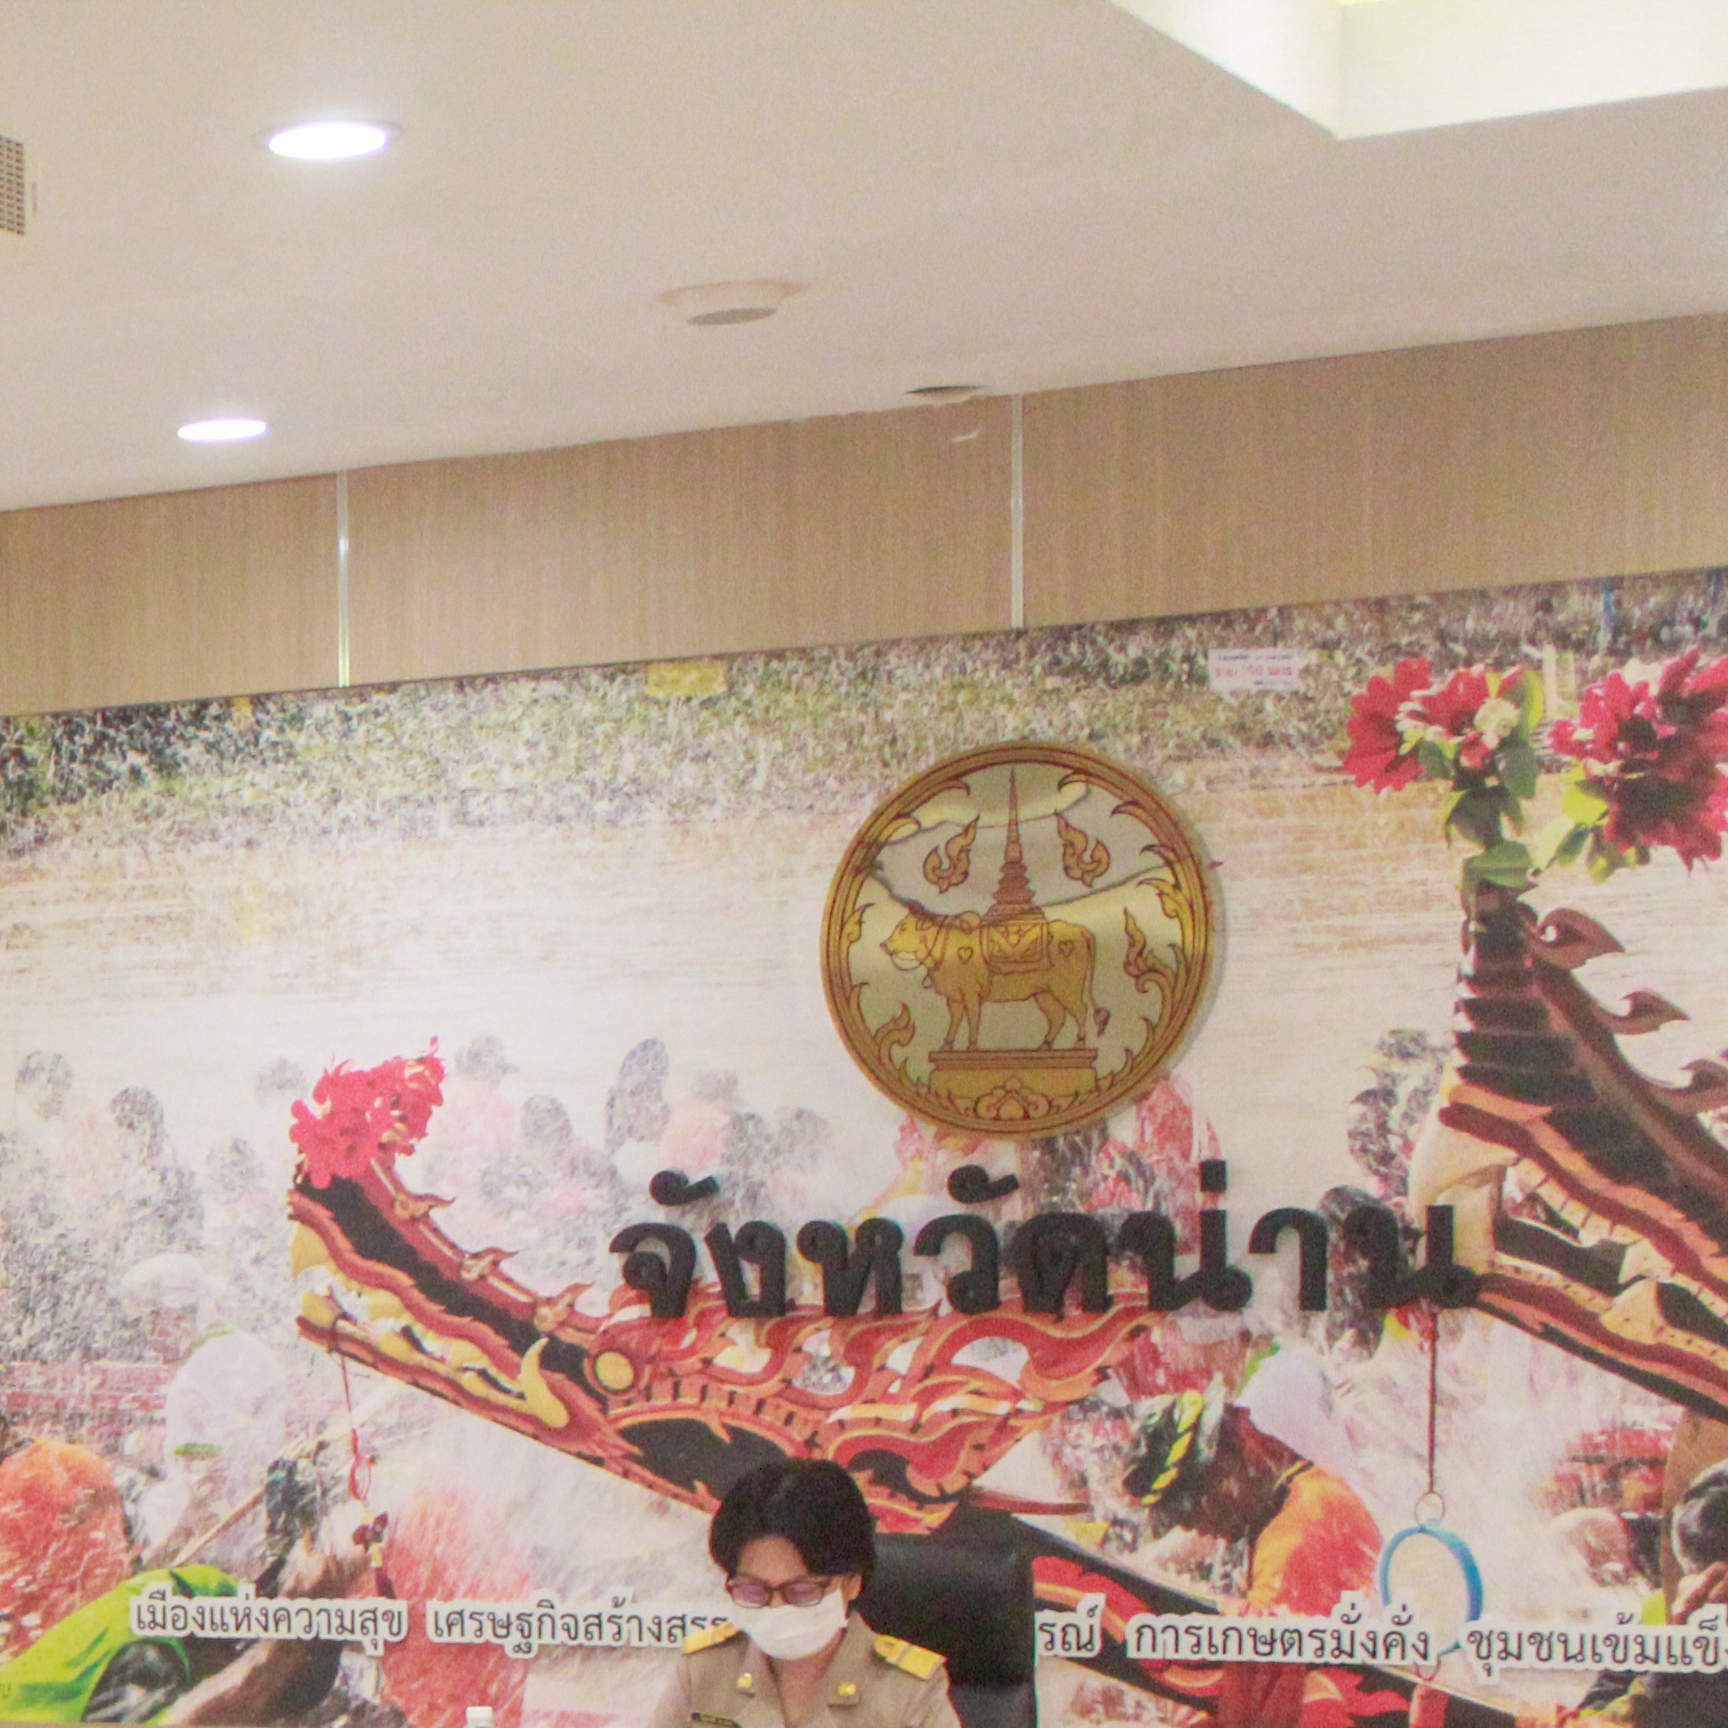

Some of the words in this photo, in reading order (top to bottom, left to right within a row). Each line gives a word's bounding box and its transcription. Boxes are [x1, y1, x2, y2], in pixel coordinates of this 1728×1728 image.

[609, 1159, 1483, 1318] จังหวัดน่าน
[135, 1589, 403, 1652] เมืองแห่งความสุข
[1135, 1606, 1430, 1662] การเกษตรมั่งคั่ง
[1466, 1612, 1728, 1678] ชุมชนเข้มแข็
